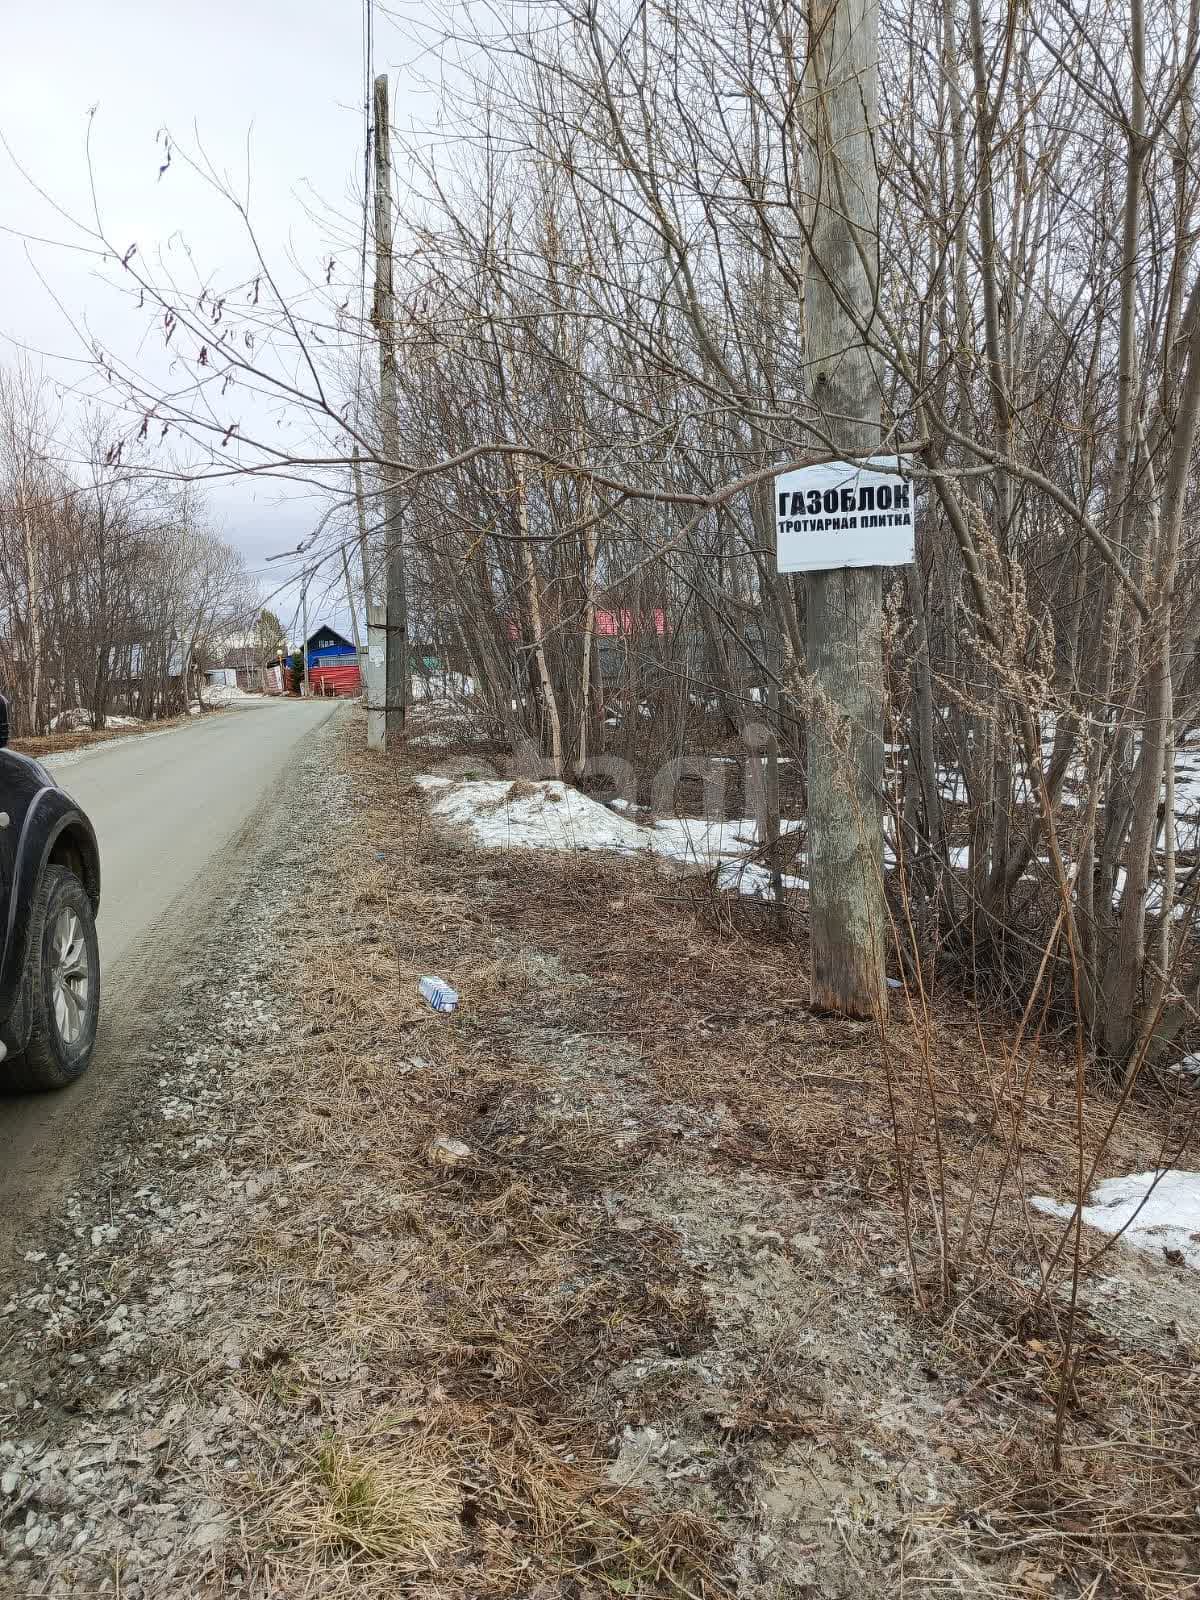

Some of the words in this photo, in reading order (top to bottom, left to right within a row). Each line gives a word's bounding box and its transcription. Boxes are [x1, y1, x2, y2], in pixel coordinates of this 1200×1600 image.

[779, 484, 910, 516] ГАЗОБЛОК
[779, 518, 857, 533] ТРОТУАРНАЯ
[861, 514, 911, 528] ПЛИТКА
